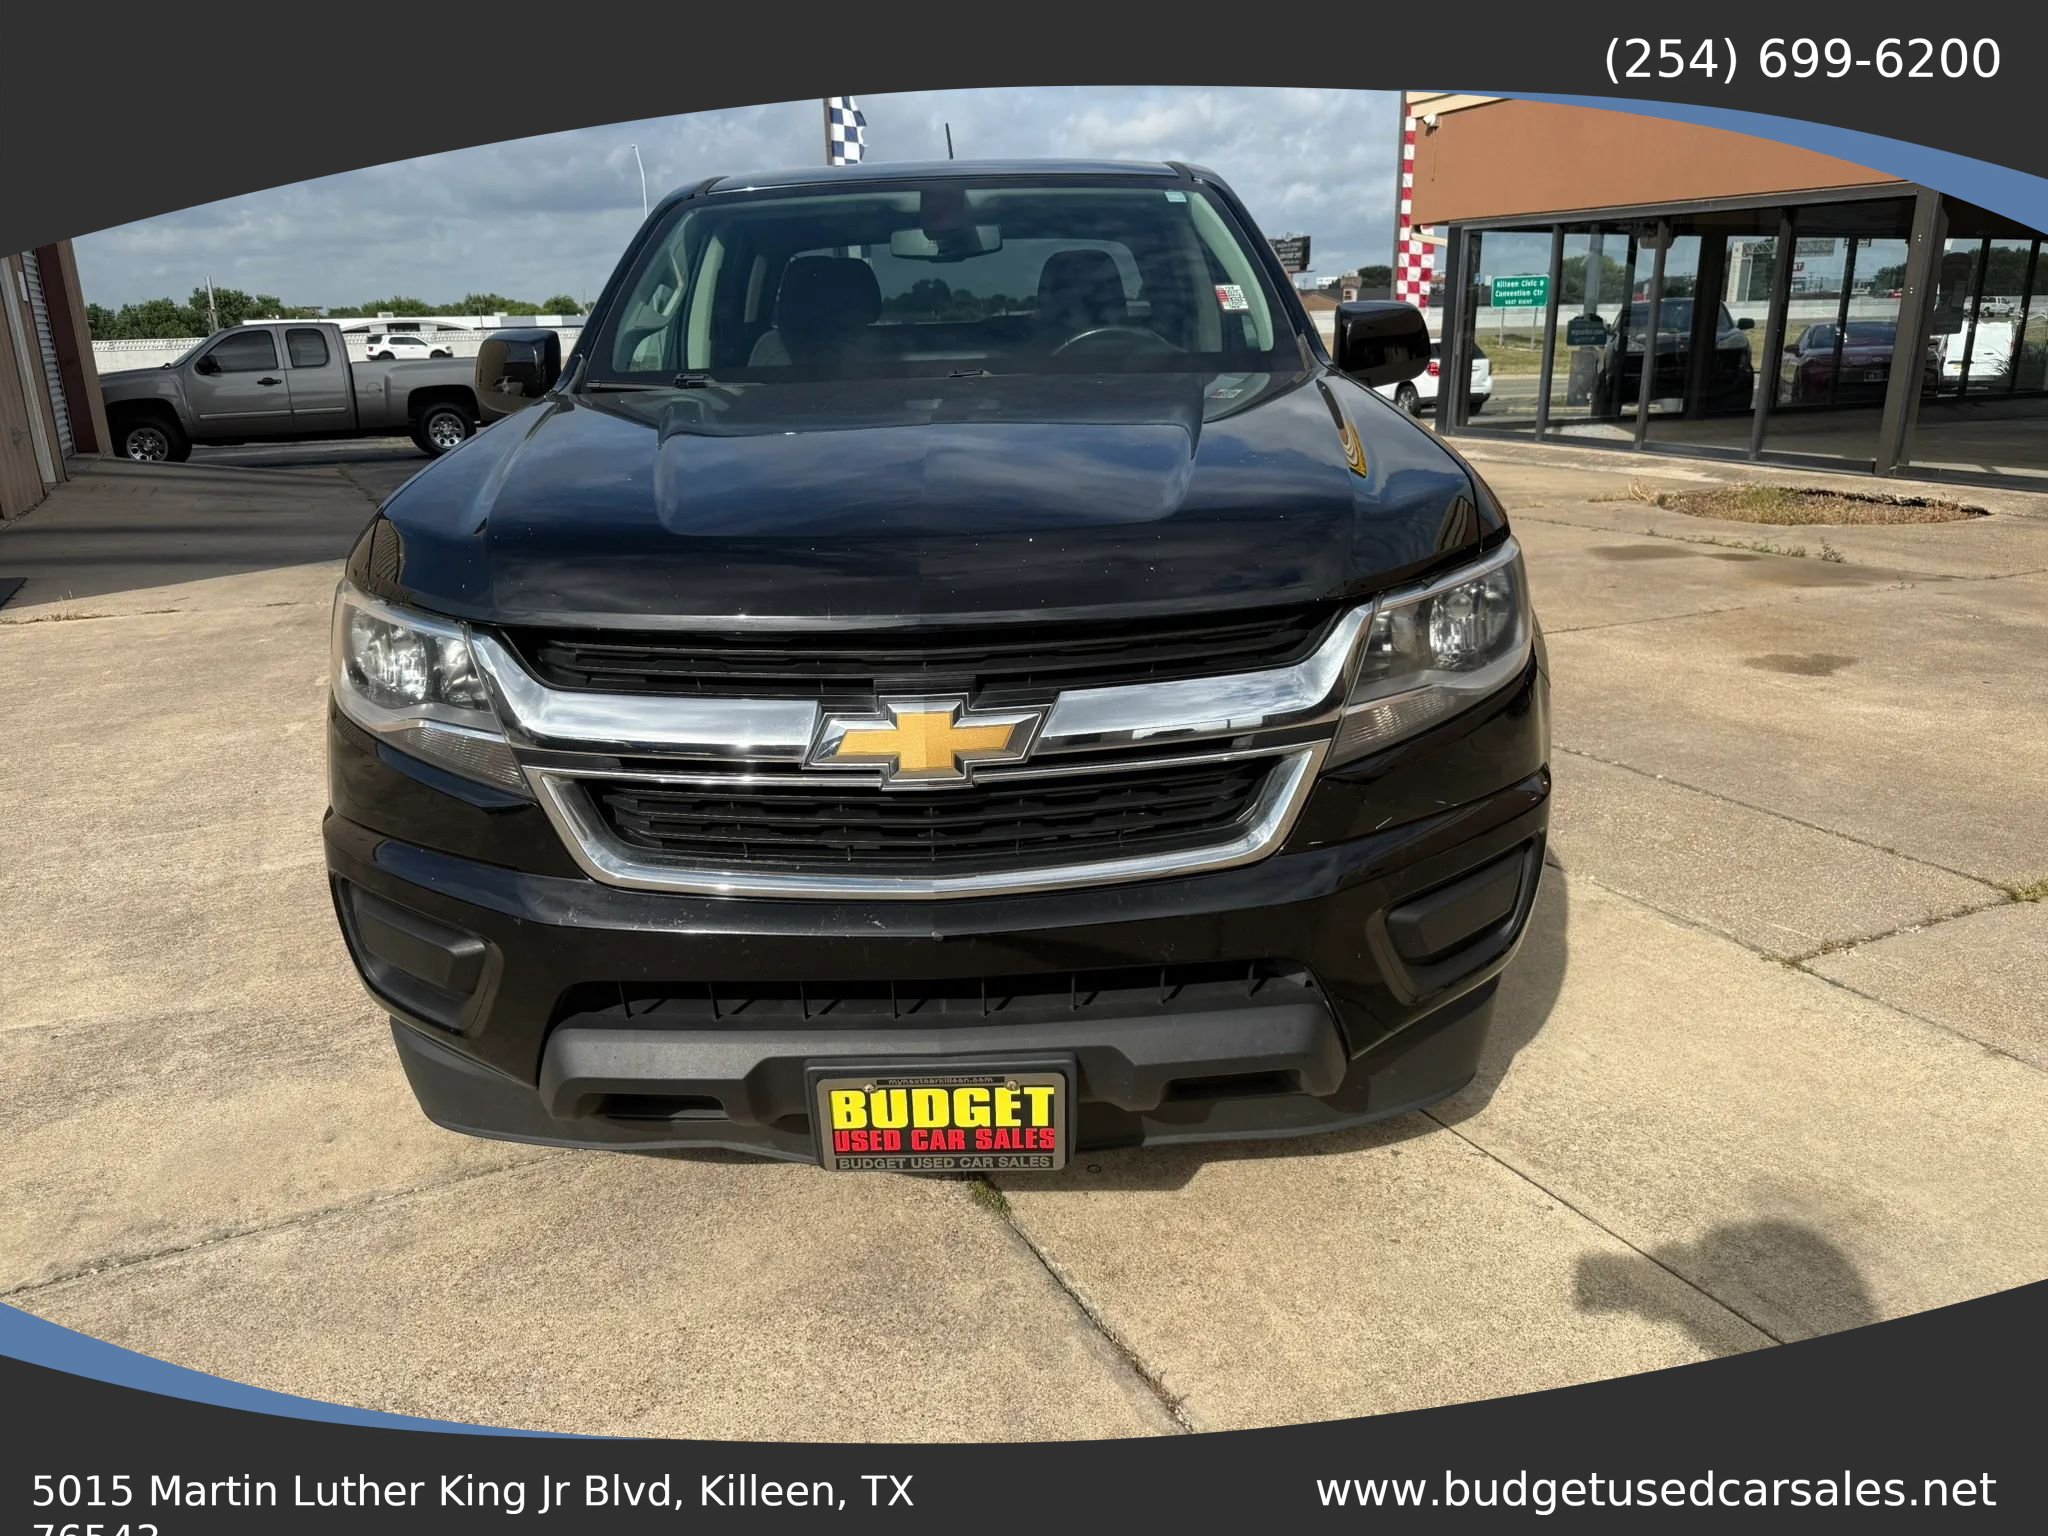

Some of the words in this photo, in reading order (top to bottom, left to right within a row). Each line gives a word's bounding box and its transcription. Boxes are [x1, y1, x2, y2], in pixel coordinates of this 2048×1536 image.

[1496, 280, 1519, 288] Killeen
[1520, 279, 1537, 287] Civic
[1533, 289, 1544, 297] Ctr
[830, 1086, 1055, 1129] BUDGET
[833, 1130, 901, 1152] USED
[911, 1129, 966, 1151] CAR
[975, 1128, 1056, 1150] SALES
[839, 1158, 907, 1170] BUDGET
[910, 1157, 955, 1169] USED
[959, 1156, 994, 1168] CAR
[998, 1156, 1050, 1168] SALES
